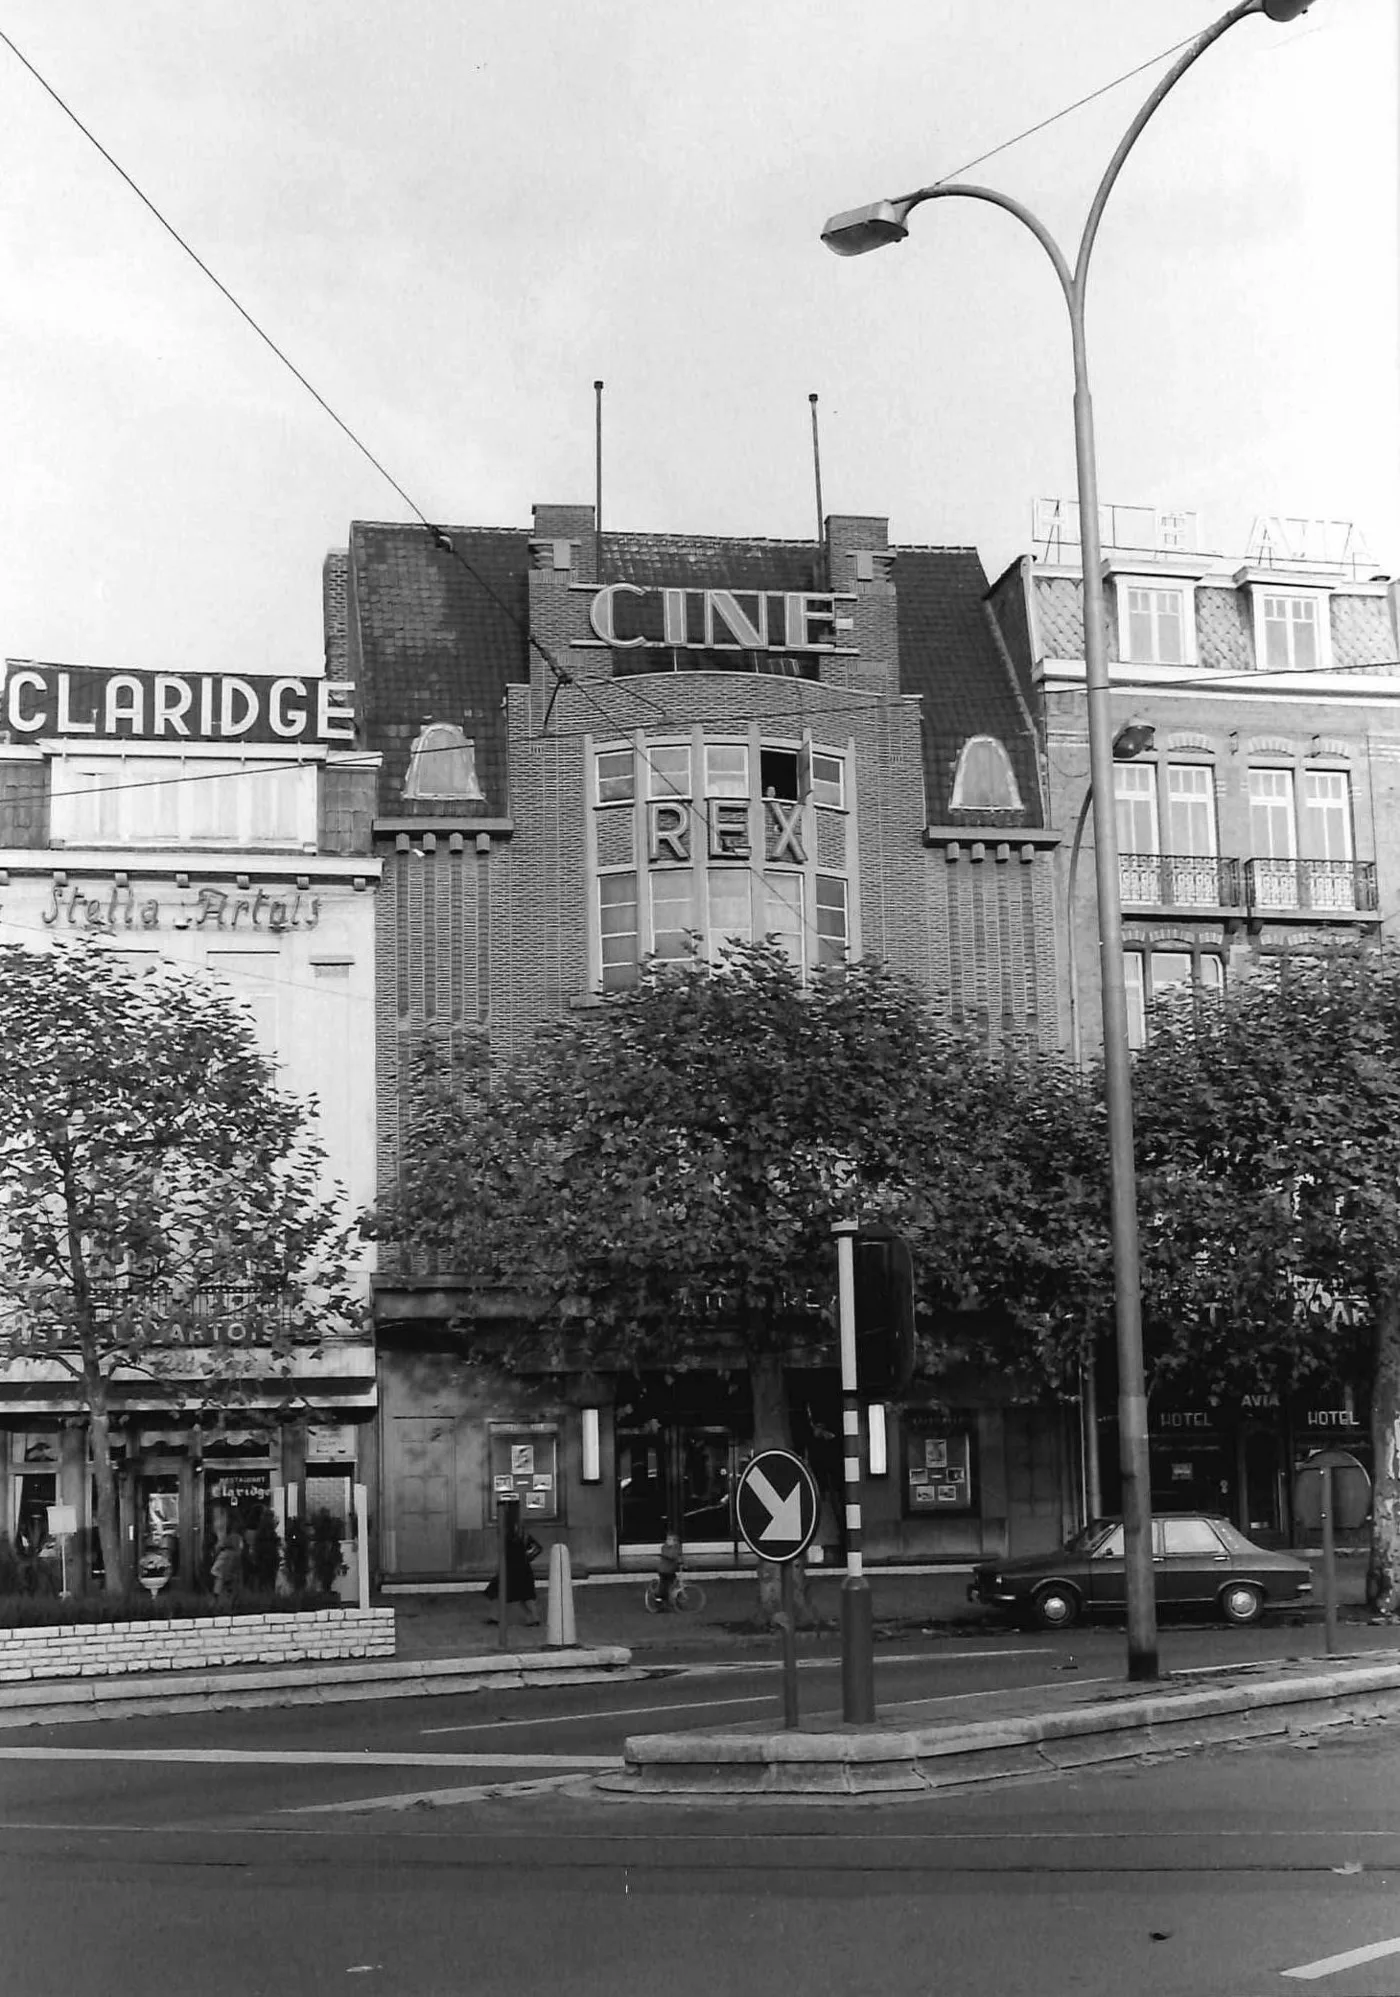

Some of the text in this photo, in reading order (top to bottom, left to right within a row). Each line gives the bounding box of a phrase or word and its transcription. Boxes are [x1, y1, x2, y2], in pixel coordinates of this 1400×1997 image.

[590, 583, 835, 650] CINE
[8, 670, 356, 741] CLARIDGE
[649, 799, 809, 865] REX
[41, 885, 161, 925] Stella
[1160, 1412, 1214, 1428] HOTEL
[1241, 1394, 1281, 1407] AVIA
[1307, 1409, 1361, 1427] HOTEL
